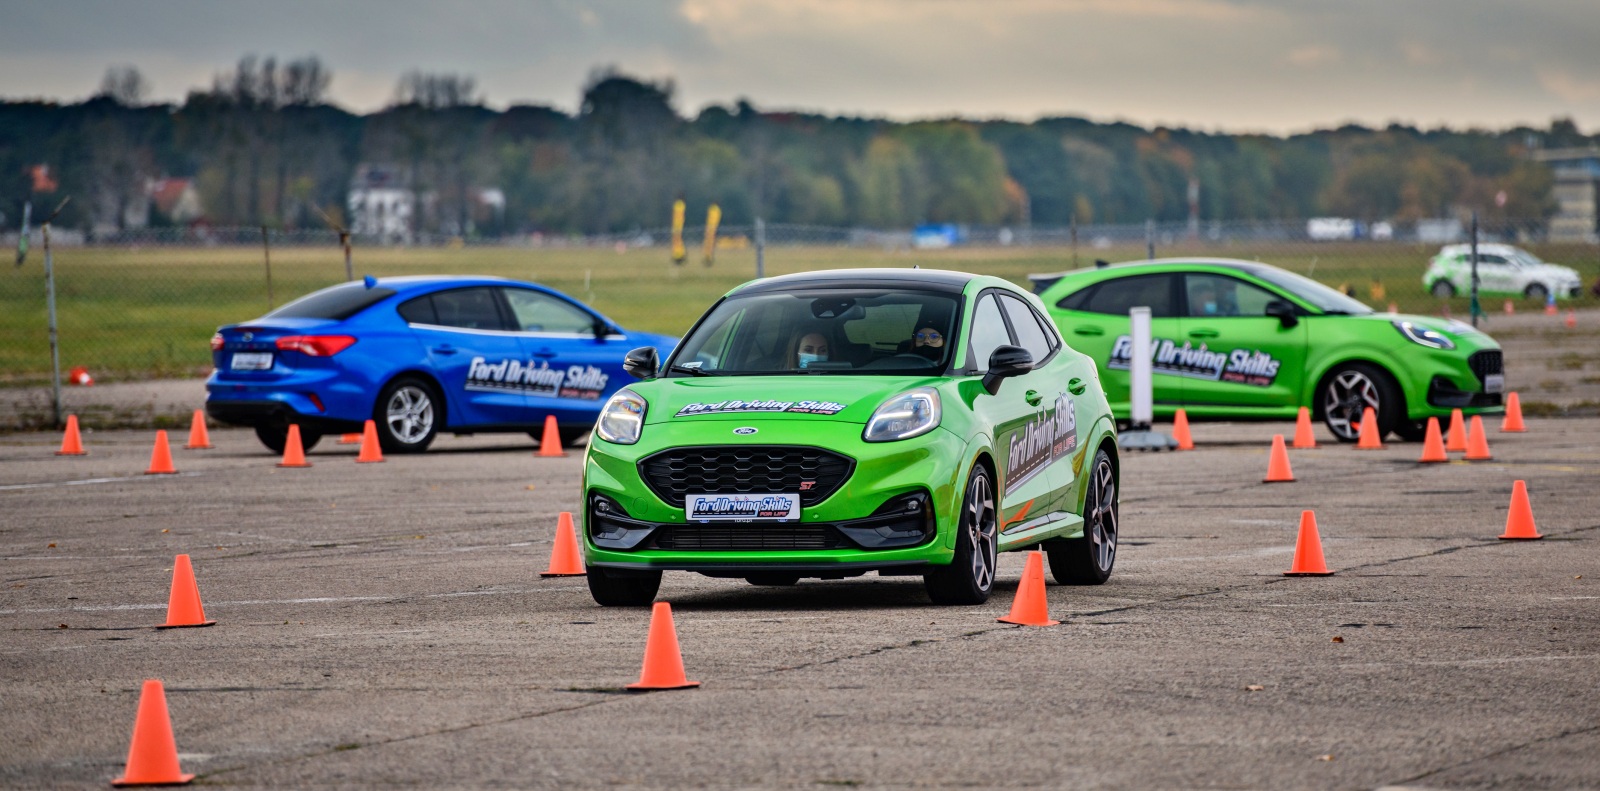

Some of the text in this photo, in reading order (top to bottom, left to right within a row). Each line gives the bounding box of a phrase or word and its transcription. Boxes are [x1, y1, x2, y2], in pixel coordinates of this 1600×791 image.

[1157, 339, 1228, 369] Driving
[1227, 348, 1281, 377] Skills
[468, 356, 609, 390] Ford Driving Skills
[680, 400, 848, 413] Ford Driving Skills
[1007, 392, 1076, 475] Ford Driving Skills
[799, 481, 816, 490] ST
[694, 497, 792, 515] Ford Driving Skills
